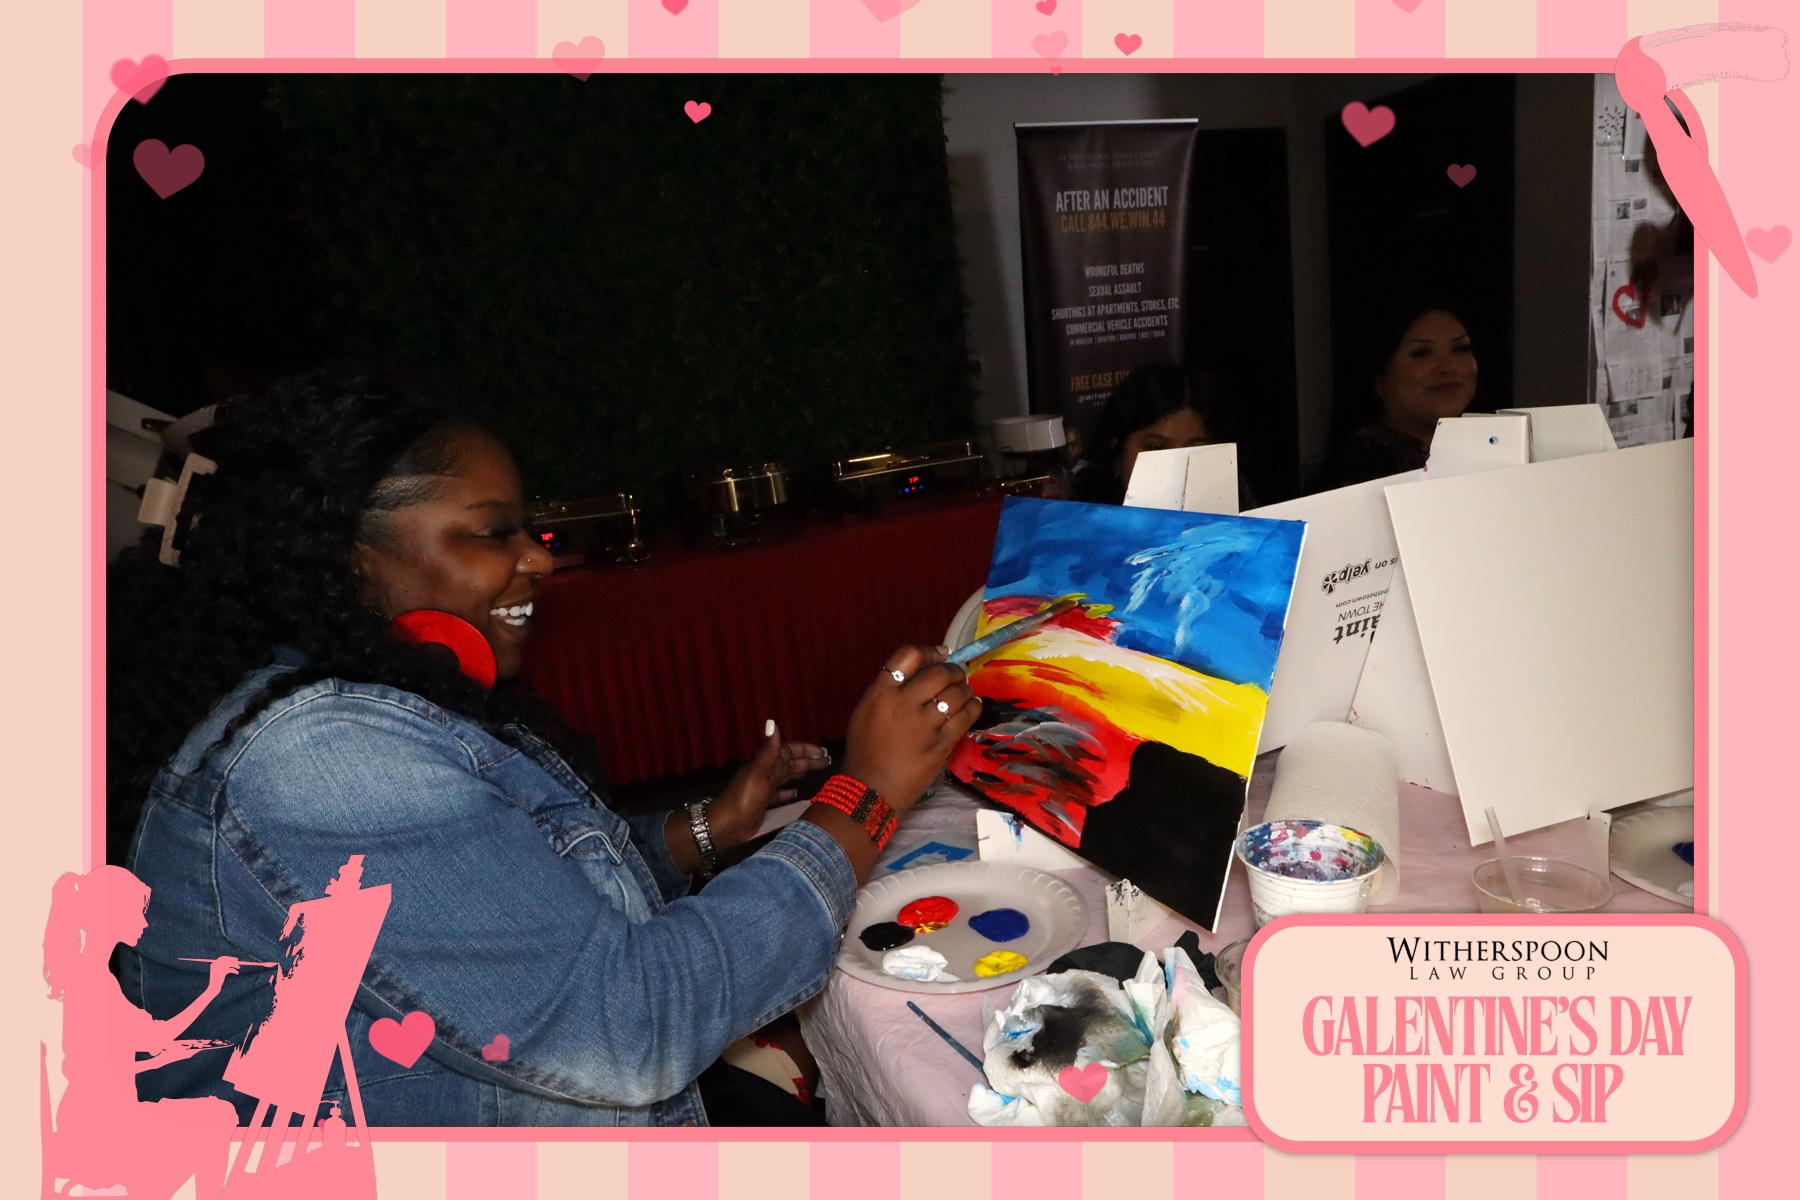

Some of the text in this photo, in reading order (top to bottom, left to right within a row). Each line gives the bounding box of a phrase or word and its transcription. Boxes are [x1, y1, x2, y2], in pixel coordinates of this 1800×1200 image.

[1056, 186, 1169, 212] AFTER AN ACCIDENT
[1061, 209, 1166, 233] CALL 844.WE.WIN.44
[1084, 262, 1145, 278] WRONGFUL DEATHS
[1089, 282, 1142, 297] SEXUAL ASSAULT
[1051, 306, 1086, 320] SHOOTINGS
[1087, 305, 1096, 316] AT
[1096, 302, 1140, 316] APARTMENTS,
[1141, 299, 1166, 312] STORES,
[1066, 315, 1168, 336] COMMERCIAL VEHICLE ACCIDENTS
[1071, 375, 1090, 391] FREE
[1092, 372, 1113, 389] CASE
[1338, 559, 1371, 582] yelp
[1375, 560, 1388, 570] on
[1338, 606, 1370, 622] TOWN
